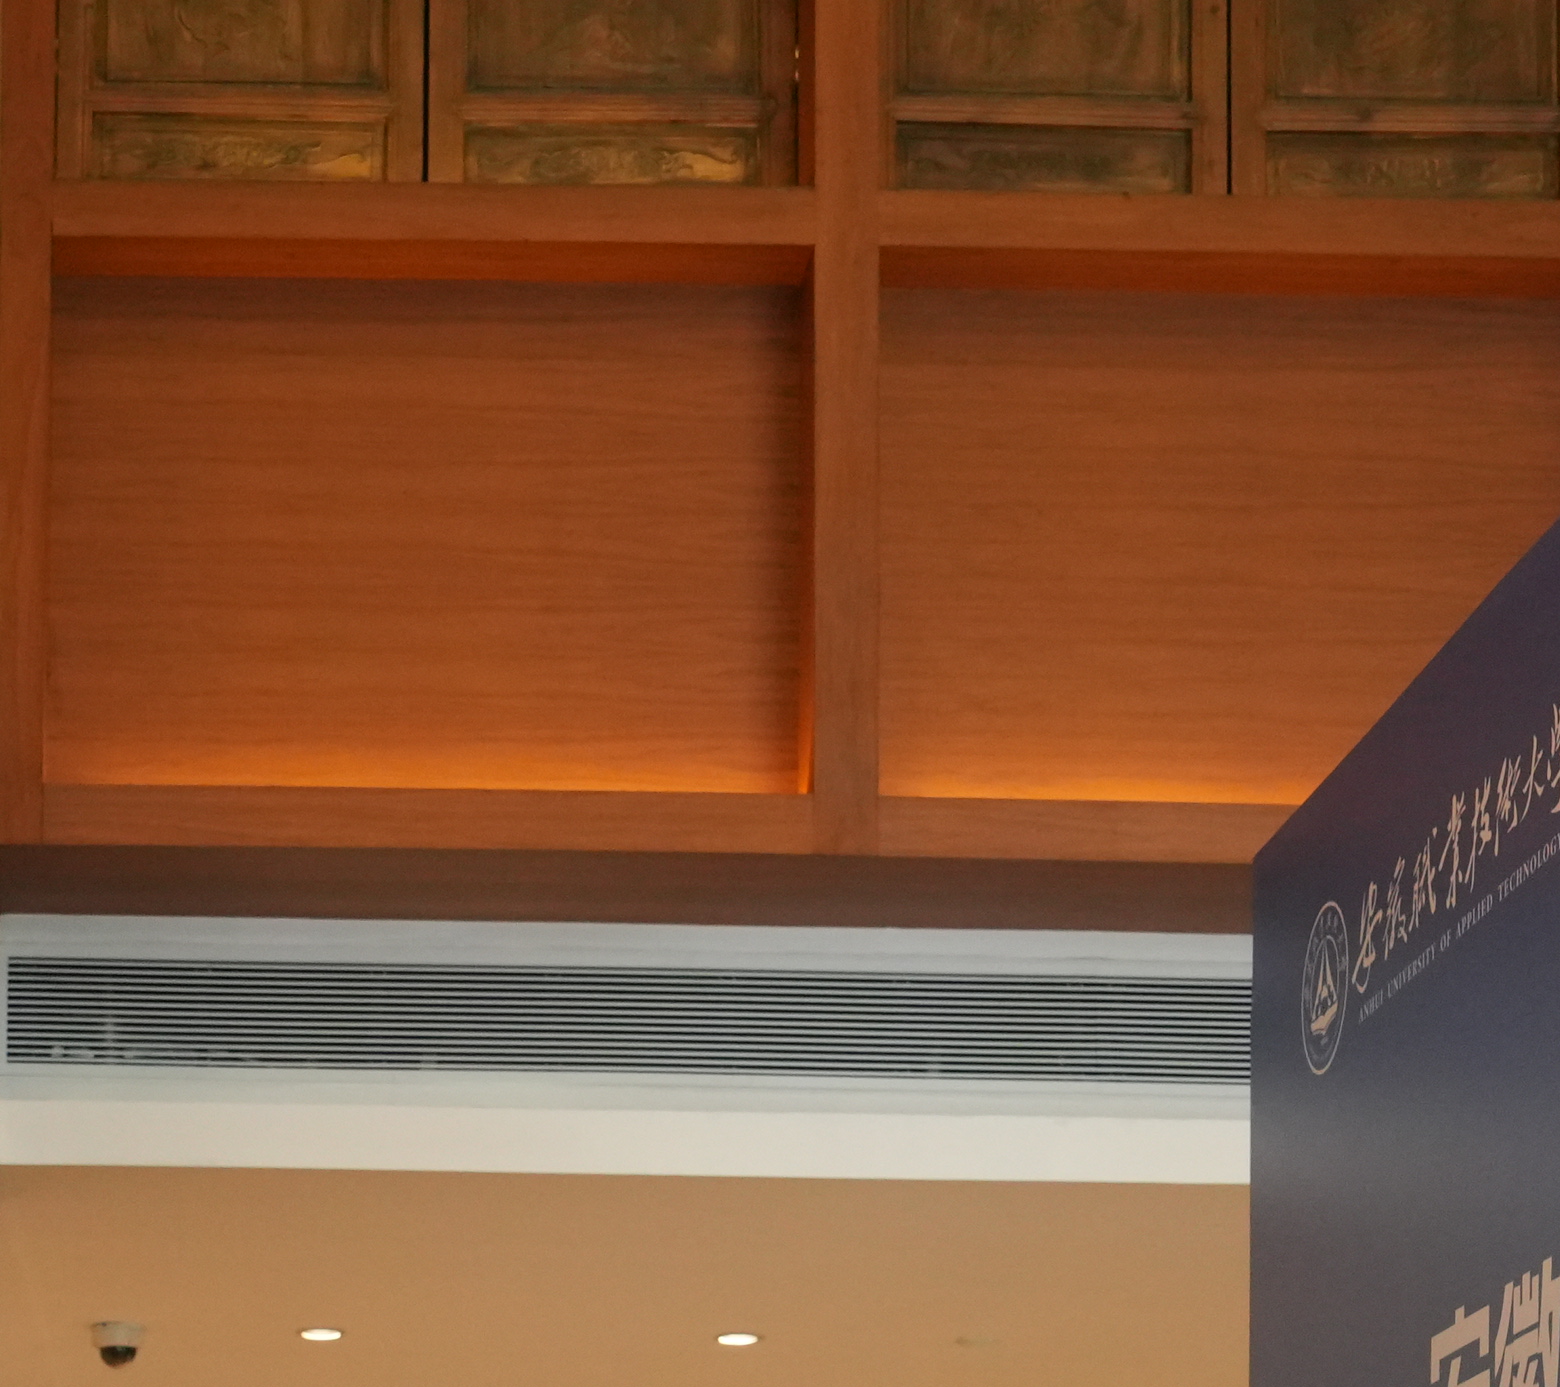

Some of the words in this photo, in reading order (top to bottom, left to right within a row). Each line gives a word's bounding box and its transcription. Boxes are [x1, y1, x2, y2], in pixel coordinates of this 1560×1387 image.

[1386, 940, 1437, 1001] UNIVERSITY
[1439, 926, 1453, 953] OF
[1455, 893, 1494, 940] APPLIED
